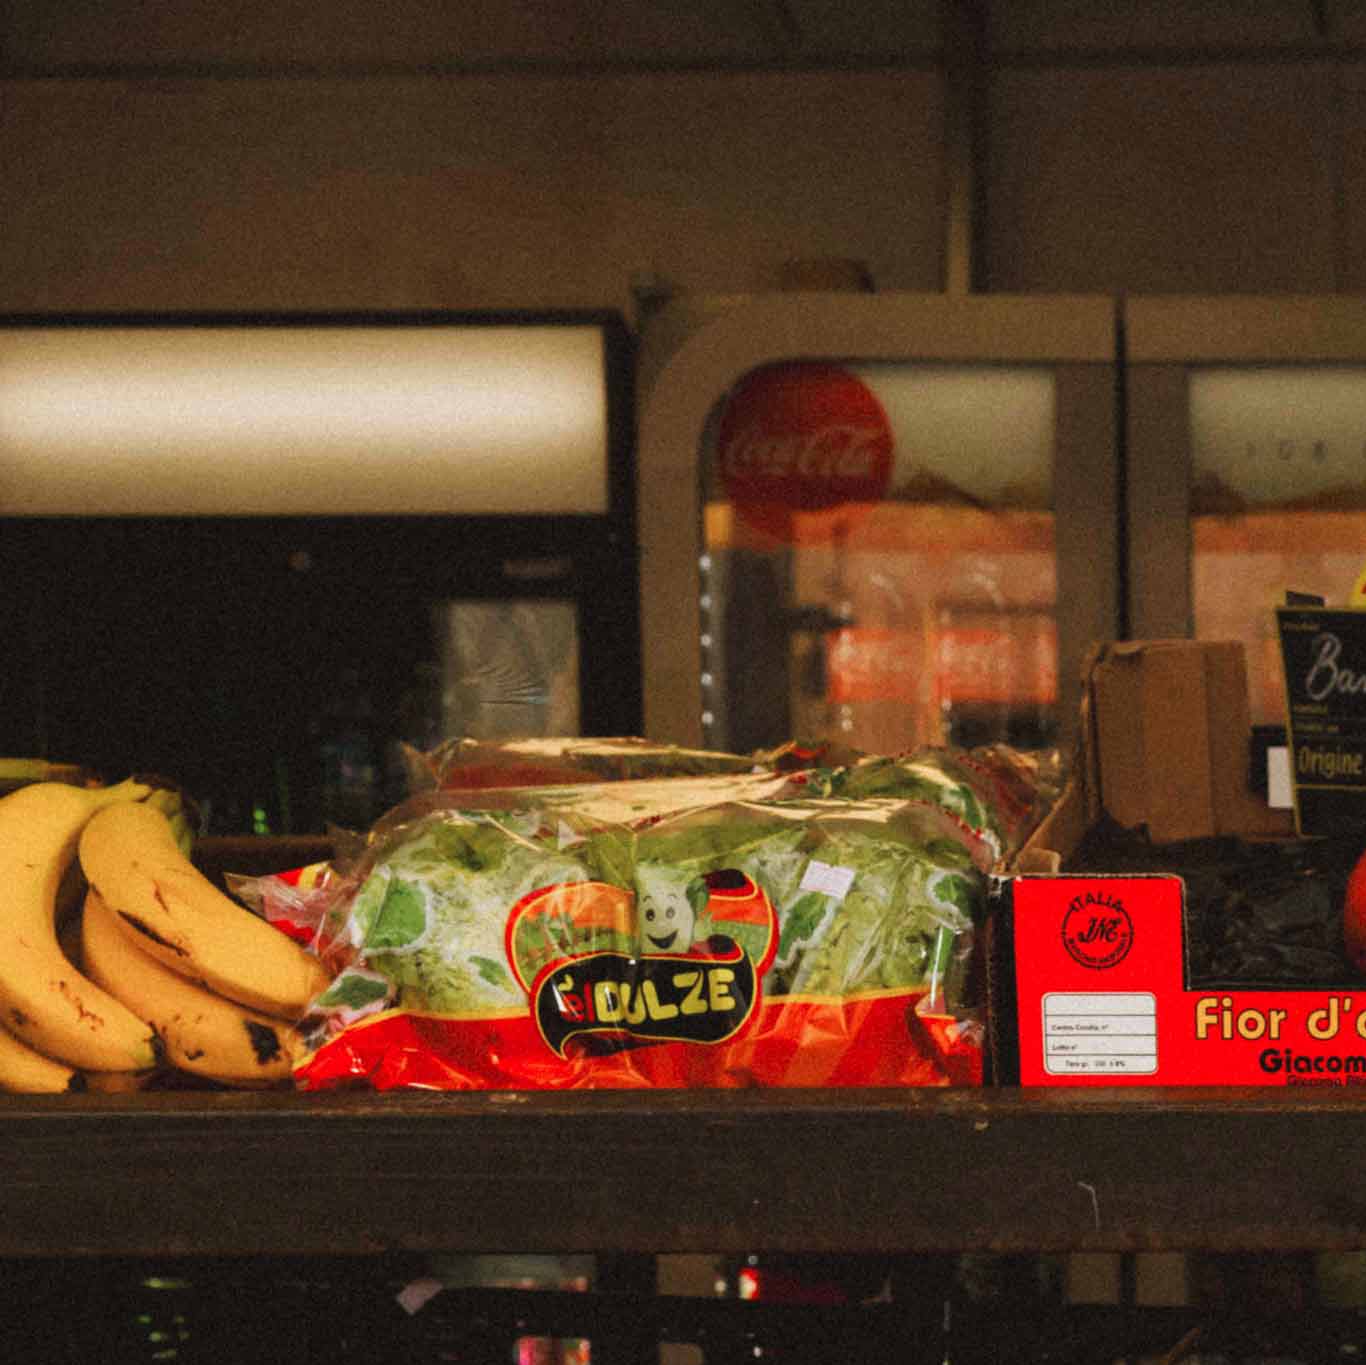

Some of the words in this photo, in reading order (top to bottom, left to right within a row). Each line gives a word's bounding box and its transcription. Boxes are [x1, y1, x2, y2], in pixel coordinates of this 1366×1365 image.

[1300, 745, 1363, 777] Origine
[1068, 891, 1124, 913] ITALIA
[594, 967, 737, 1025] DULZE
[1194, 996, 1288, 1041] Fior
